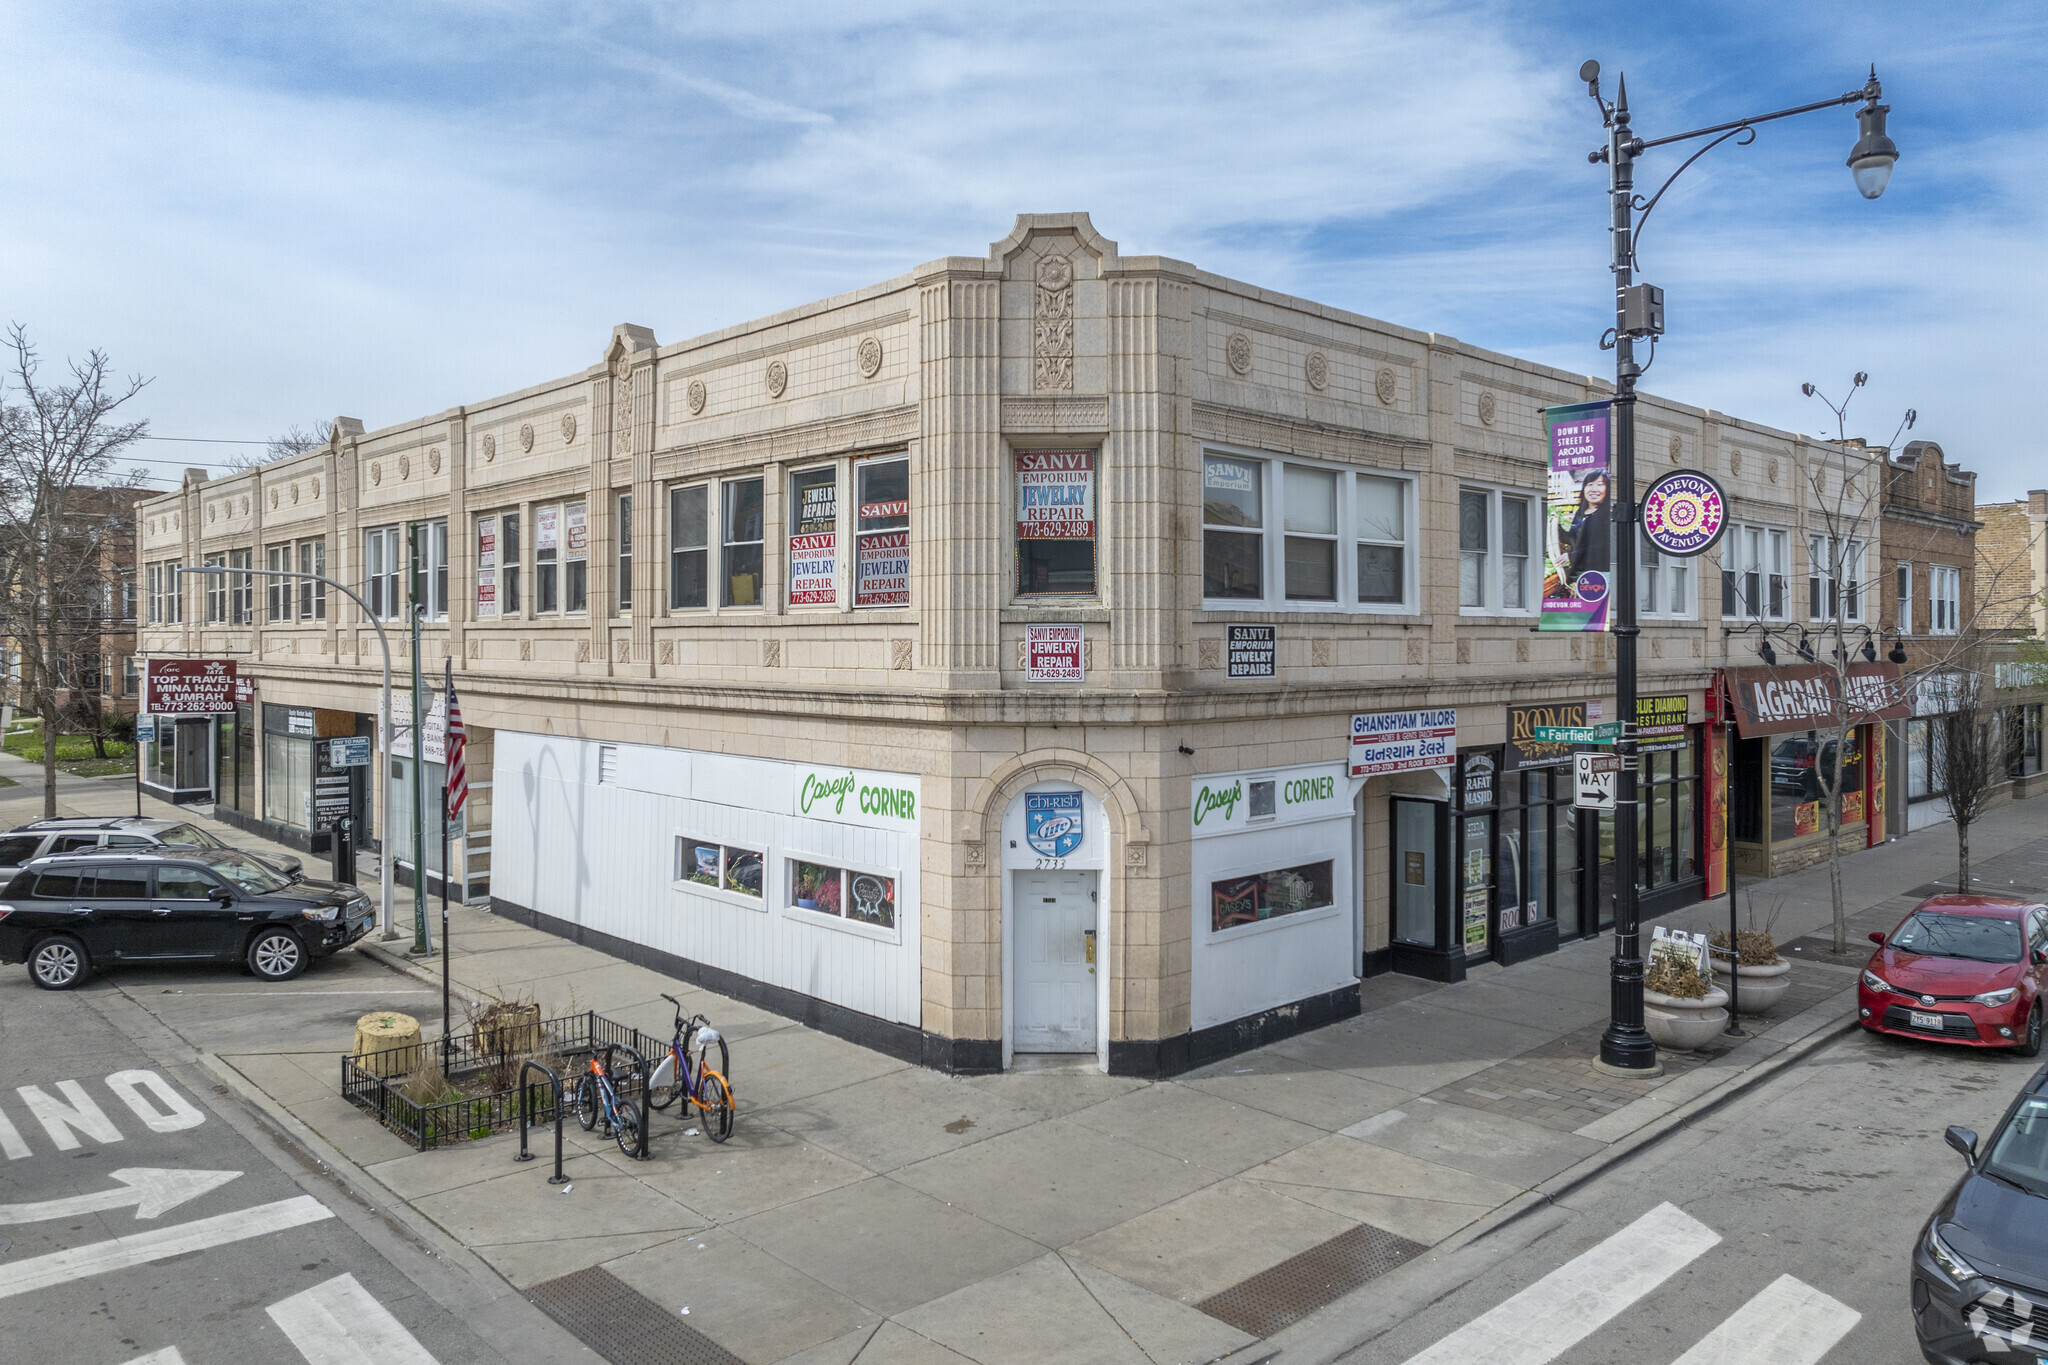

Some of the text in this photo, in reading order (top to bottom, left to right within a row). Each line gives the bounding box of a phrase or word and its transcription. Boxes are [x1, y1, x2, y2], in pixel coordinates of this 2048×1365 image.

[1558, 424, 1594, 436] DOWN THE
[1558, 436, 1582, 446] STREET
[1558, 446, 1594, 456] AROUND
[1022, 454, 1087, 470] SANVI
[1558, 455, 1594, 466] THE WORLD
[1022, 472, 1087, 483] EMPORIUM
[1208, 463, 1249, 482] SANVI
[1208, 478, 1250, 489] Emporium
[1664, 479, 1708, 494] DEVON
[1022, 485, 1086, 510] JEWELRY
[802, 502, 836, 518] REPAIRS
[861, 502, 908, 517] SANVI
[1028, 508, 1084, 520] REPAIR
[801, 522, 836, 533] 629-2489
[1022, 522, 1088, 536] 773-629-2489
[792, 535, 835, 549] SANVI
[861, 534, 909, 549] SANVI
[1659, 534, 1703, 547] AVENUE
[793, 549, 834, 560] EMPORIUM
[861, 548, 909, 560] EMPORIUM
[792, 560, 835, 578] JEWELRY
[861, 560, 909, 579] JEWELRY
[796, 578, 832, 590] REPAIR
[863, 578, 905, 590] REPAIR
[1580, 584, 1605, 592] DEVON
[792, 591, 835, 602] 773-629-2489
[860, 592, 908, 604] 773-629-2489
[1030, 628, 1079, 640] SANVI EMPORIUM
[1234, 628, 1270, 640] SANVI
[1032, 643, 1078, 654] JEWELRY
[1230, 641, 1273, 650] EMPORIUM
[1037, 656, 1072, 667] REPAIR
[1230, 651, 1273, 662] JEWELRY
[1031, 669, 1080, 677] 773-629-2489
[1231, 664, 1272, 675] REPAIRS
[150, 676, 235, 684] TOP TRAVEL
[156, 684, 229, 692] MINA HAJJ
[161, 693, 224, 701] & UMRAH
[1636, 696, 1687, 714] BLUE DIAMOND
[1354, 710, 1455, 733] GHANSHYAM TAILORS
[1378, 734, 1395, 742] LADIES
[1402, 732, 1417, 740] GENTS
[1418, 730, 1433, 738] TAILOR
[1549, 729, 1594, 741] Fairfield
[1599, 726, 1614, 737] Devon
[1408, 759, 1423, 768] FLOOR
[1466, 776, 1492, 790] RAFAT
[1579, 773, 1610, 786] WAY
[801, 771, 915, 820] Casey's CORNER
[1194, 776, 1334, 826] Casey's CORNER
[1464, 790, 1492, 805] MASJID
[1044, 822, 1068, 838] Lite
[1035, 858, 1066, 870] 2733
[1502, 904, 1536, 929] ROOIS
